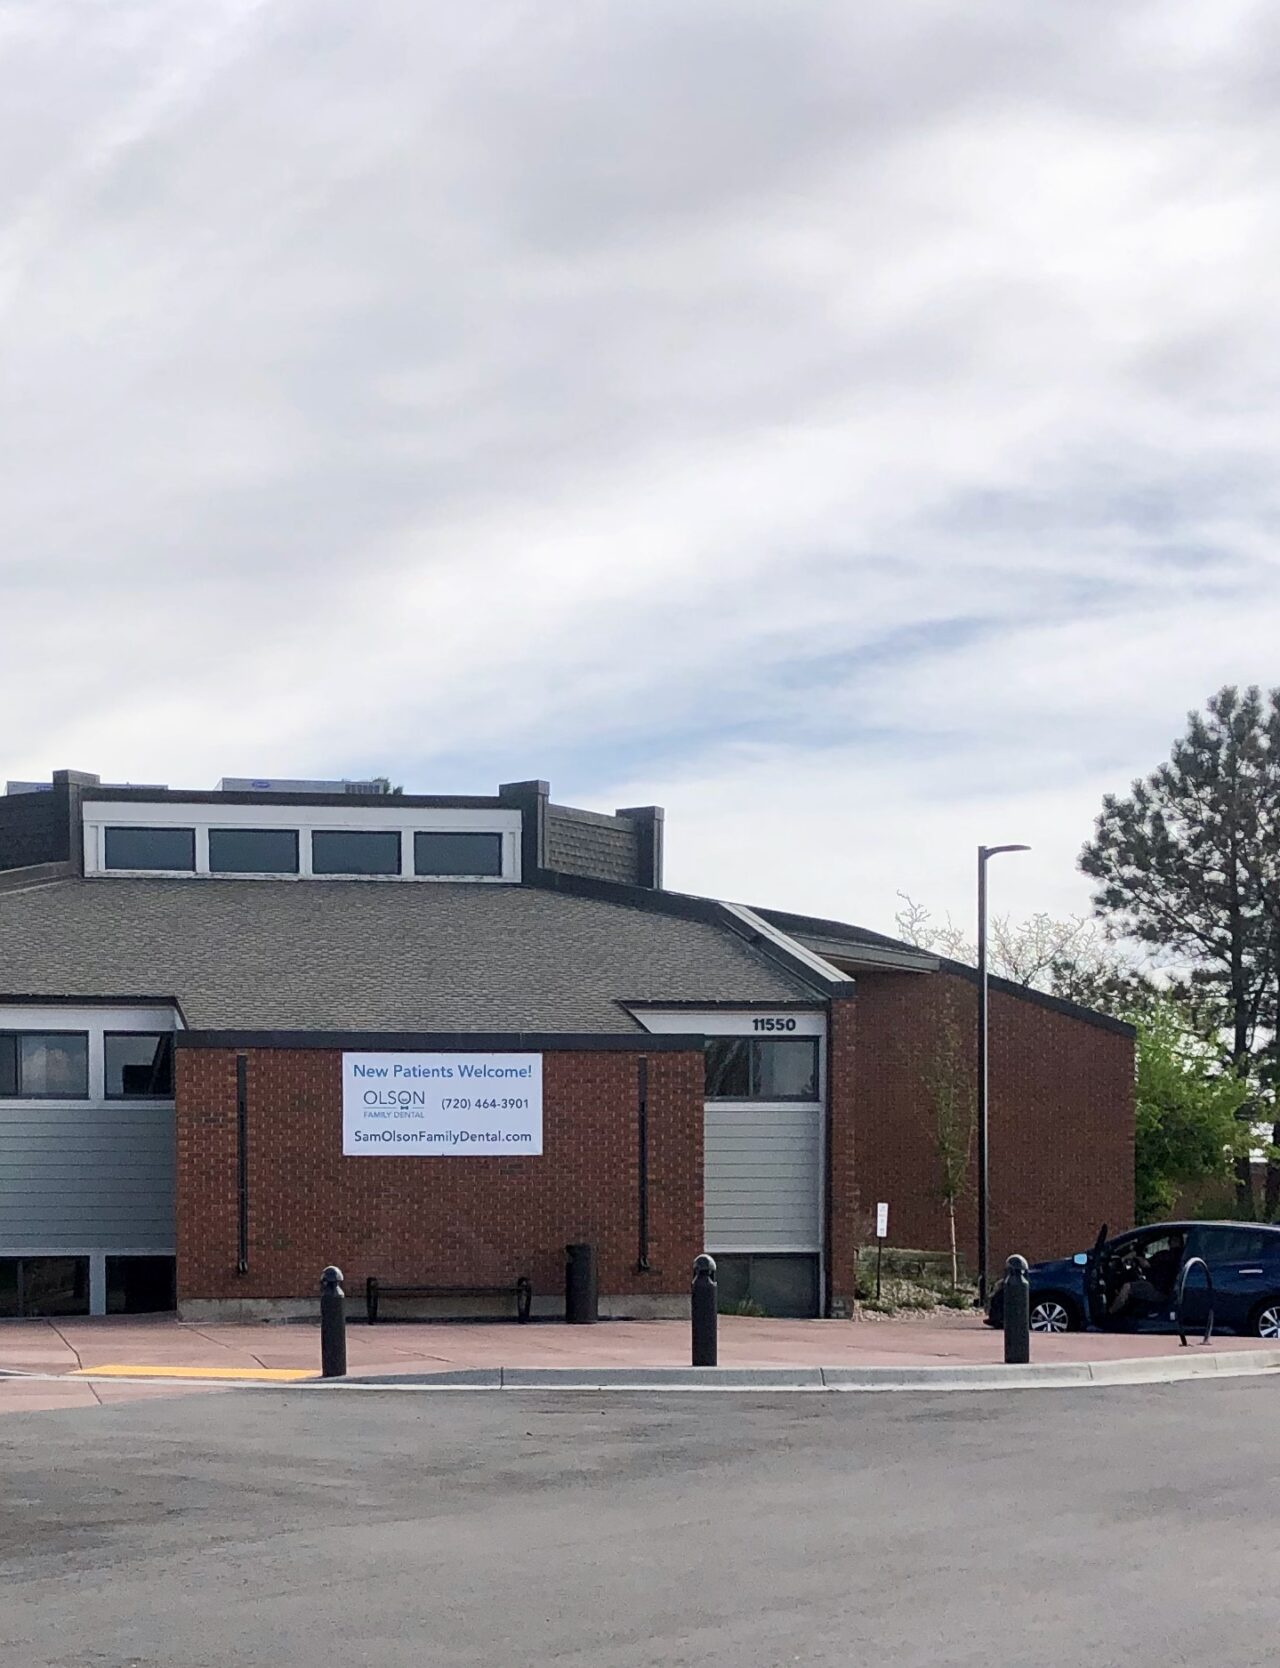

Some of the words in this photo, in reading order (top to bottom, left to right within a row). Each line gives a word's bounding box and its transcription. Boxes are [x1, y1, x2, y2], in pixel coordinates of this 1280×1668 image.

[752, 1018, 796, 1031] 11550
[353, 1064, 388, 1078] New
[393, 1064, 453, 1078] Patients
[458, 1064, 532, 1078] Welcome!
[363, 1090, 425, 1105] OLSON
[441, 1098, 471, 1111] (720)
[474, 1098, 529, 1110] 464-3901
[363, 1111, 391, 1119] FAMILY
[393, 1111, 425, 1119] DENTAL
[354, 1130, 532, 1145] SamOlsonFamilyDental.com
